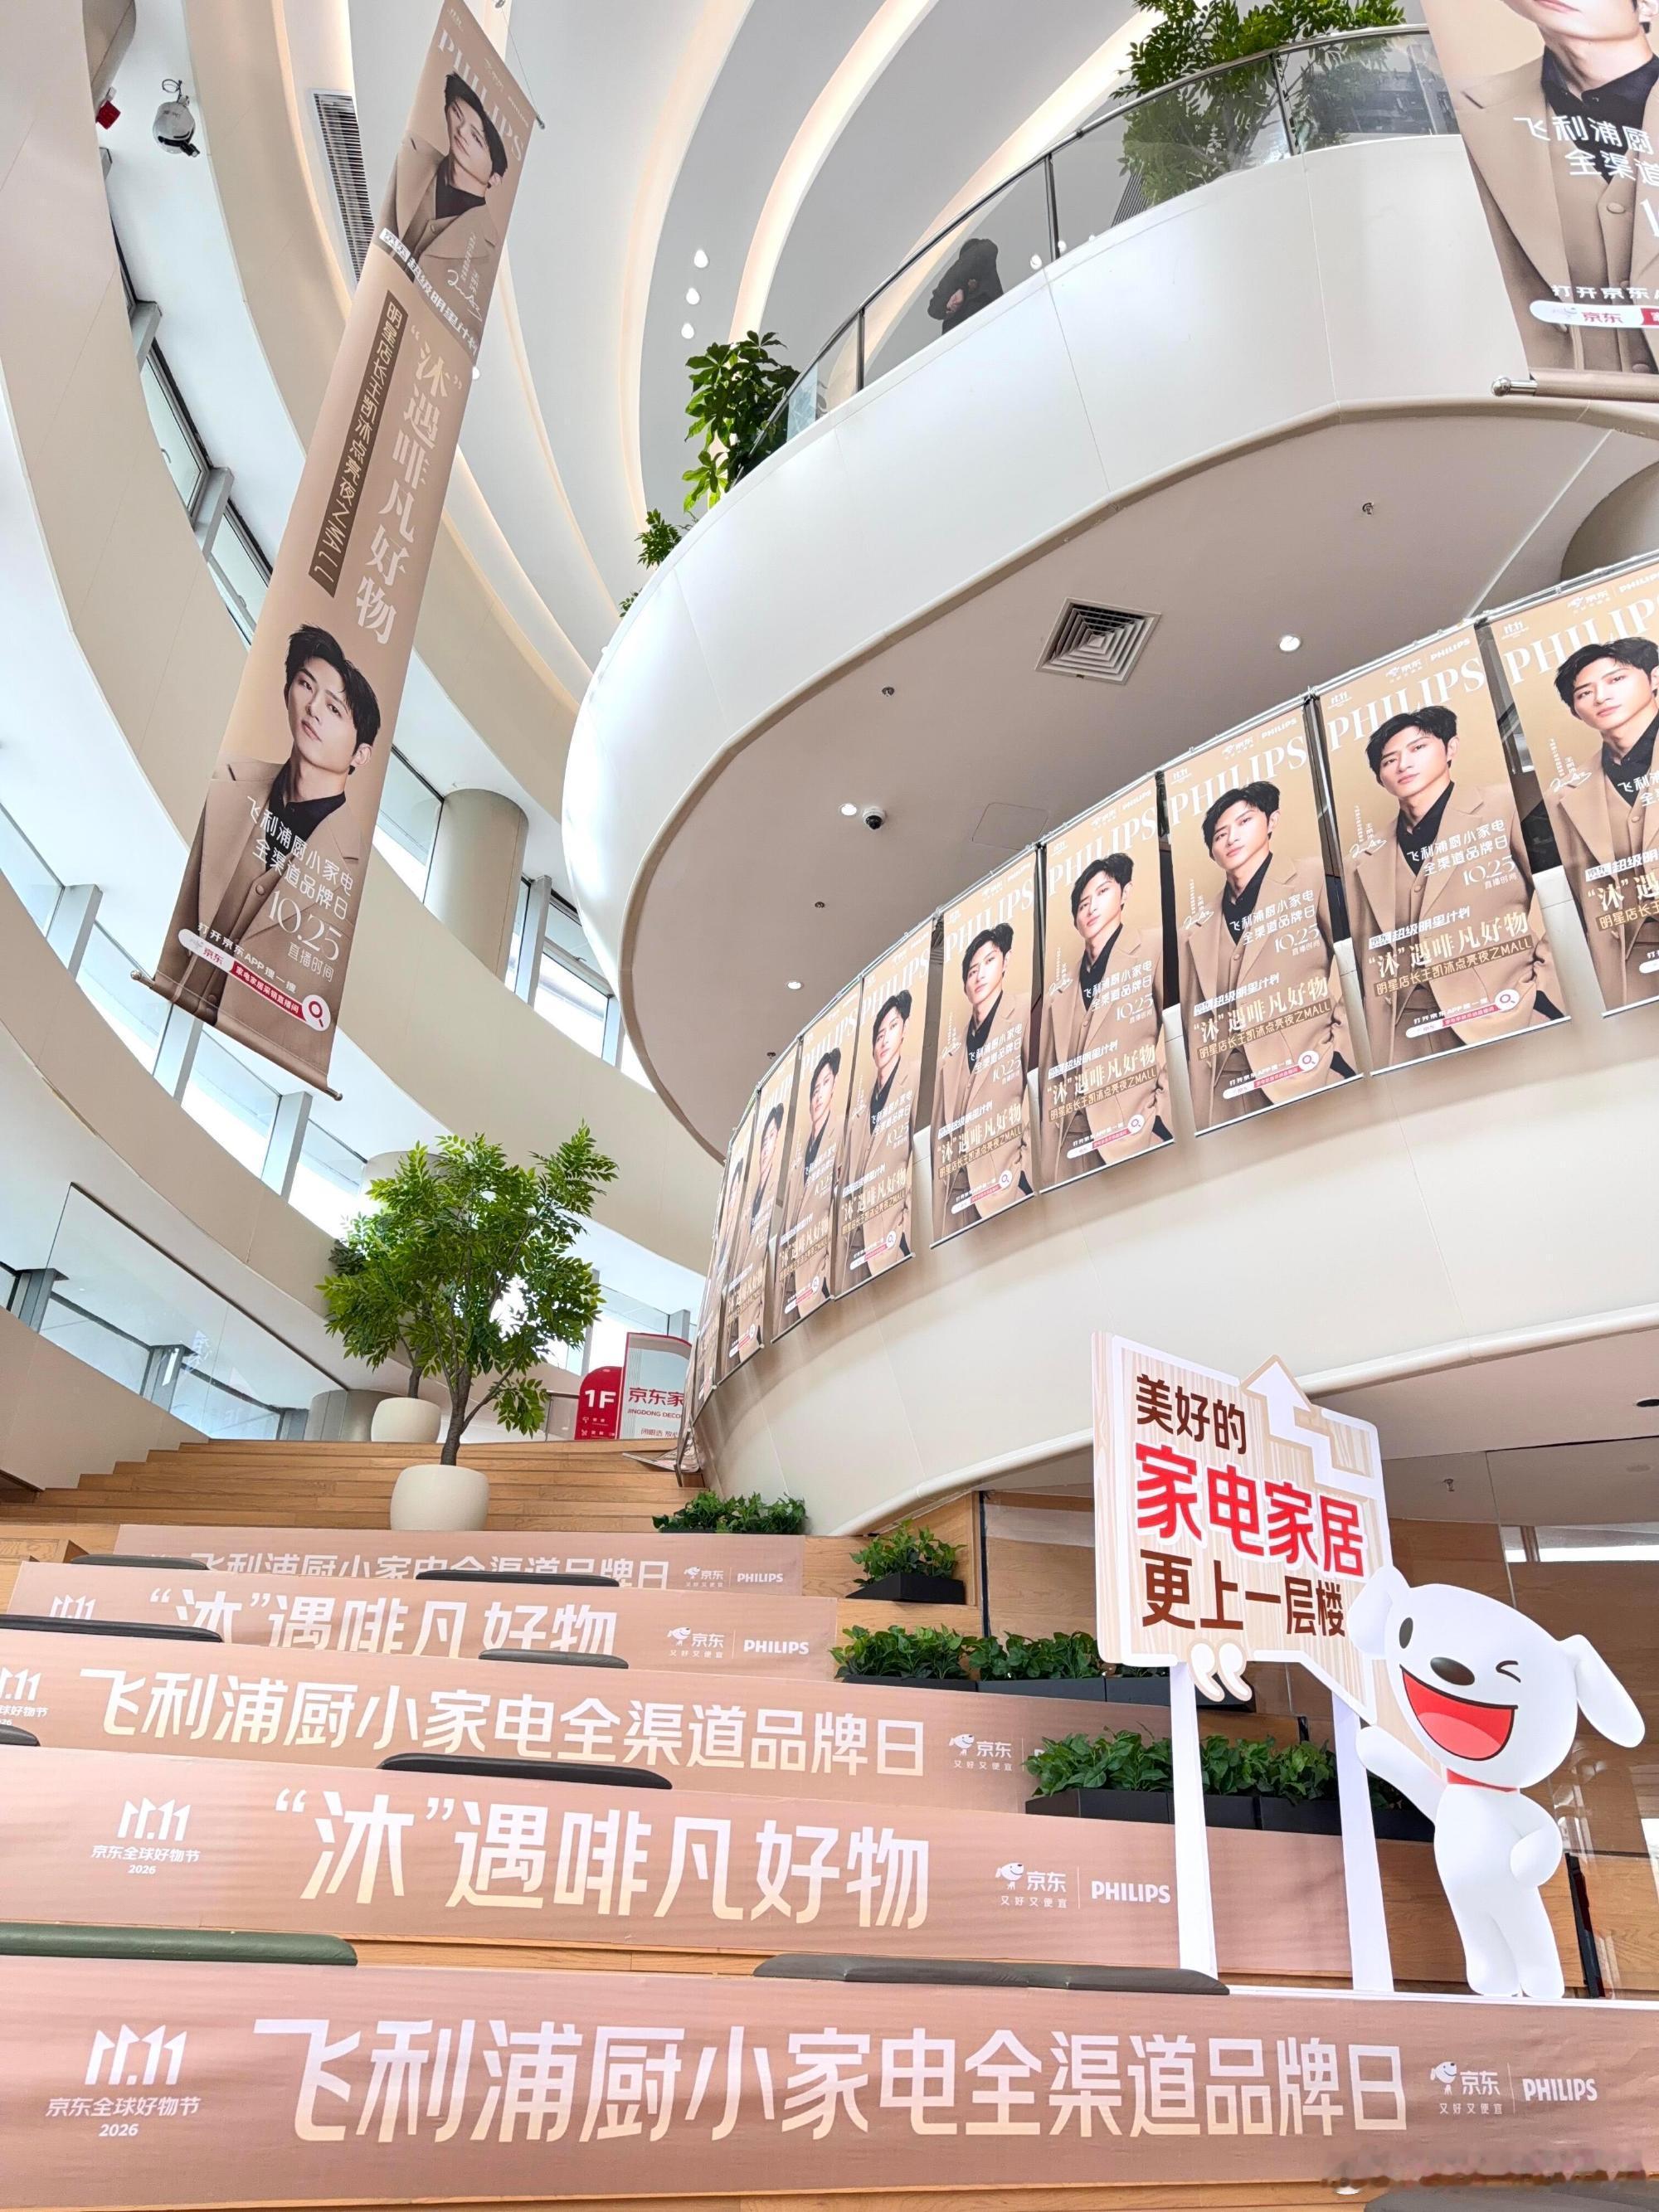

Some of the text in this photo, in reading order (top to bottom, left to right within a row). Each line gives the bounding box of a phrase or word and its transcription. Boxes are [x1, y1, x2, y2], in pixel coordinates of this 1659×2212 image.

[1581, 310, 1623, 324] 京东
[1503, 596, 1659, 686] PHILIP
[247, 795, 355, 898] 飞利浦厨小家电
[1407, 819, 1505, 863] 飞利浦厨小家电
[1423, 836, 1509, 877] 全渠道品牌日
[252, 839, 349, 920] 全渠道品牌日
[268, 889, 343, 960] 10.25
[1274, 923, 1321, 954] 10.25
[1392, 905, 1471, 941] 超级明星计划
[197, 921, 297, 994] 打开京东APP搜一搜
[202, 946, 225, 967] 京东
[287, 941, 335, 982] 直播时间
[1369, 912, 1529, 979] “沐”遇啡凡好物
[1376, 939, 1532, 997] 明星店长王凯沐点亮夜之MALL
[1194, 976, 1329, 1044] “沐”遇啡凡好物
[585, 1389, 616, 1409] 1F
[628, 1387, 684, 1407] 京东家
[1136, 1373, 1247, 1455] 美好的
[1136, 1443, 1364, 1577] 家电家居
[701, 1570, 723, 1580] 京东
[737, 1573, 783, 1583] PHILIPS
[1141, 1549, 1346, 1637] 更上一层楼
[149, 1587, 618, 1659] “沐”遇啡凡好物
[692, 1633, 724, 1647] 京东
[743, 1639, 810, 1655] PHILIPS
[80, 1668, 925, 1777] 飞利浦厨小家电全渠道品牌日
[975, 1741, 1011, 1758] 京东
[954, 1760, 1013, 1772] 又好又便宜
[90, 1845, 200, 1864] 京东全球好物节
[127, 1864, 156, 1875] 2026
[275, 1787, 930, 1930] “沐”遇啡凡好物
[1027, 1870, 1067, 1894] 京东
[1000, 1895, 1068, 1909] 又好又便宜
[1091, 1880, 1171, 1905] PHILIPS
[252, 2017, 1408, 2143] 飞利浦厨小家电全渠道品牌日
[1459, 2070, 1501, 2095] 京东
[1521, 2077, 1598, 2103] PHILIPS
[45, 2097, 201, 2117] 京东全球好物节
[1438, 2102, 1504, 2116] 又好又便宜
[100, 2122, 139, 2138] 2026
